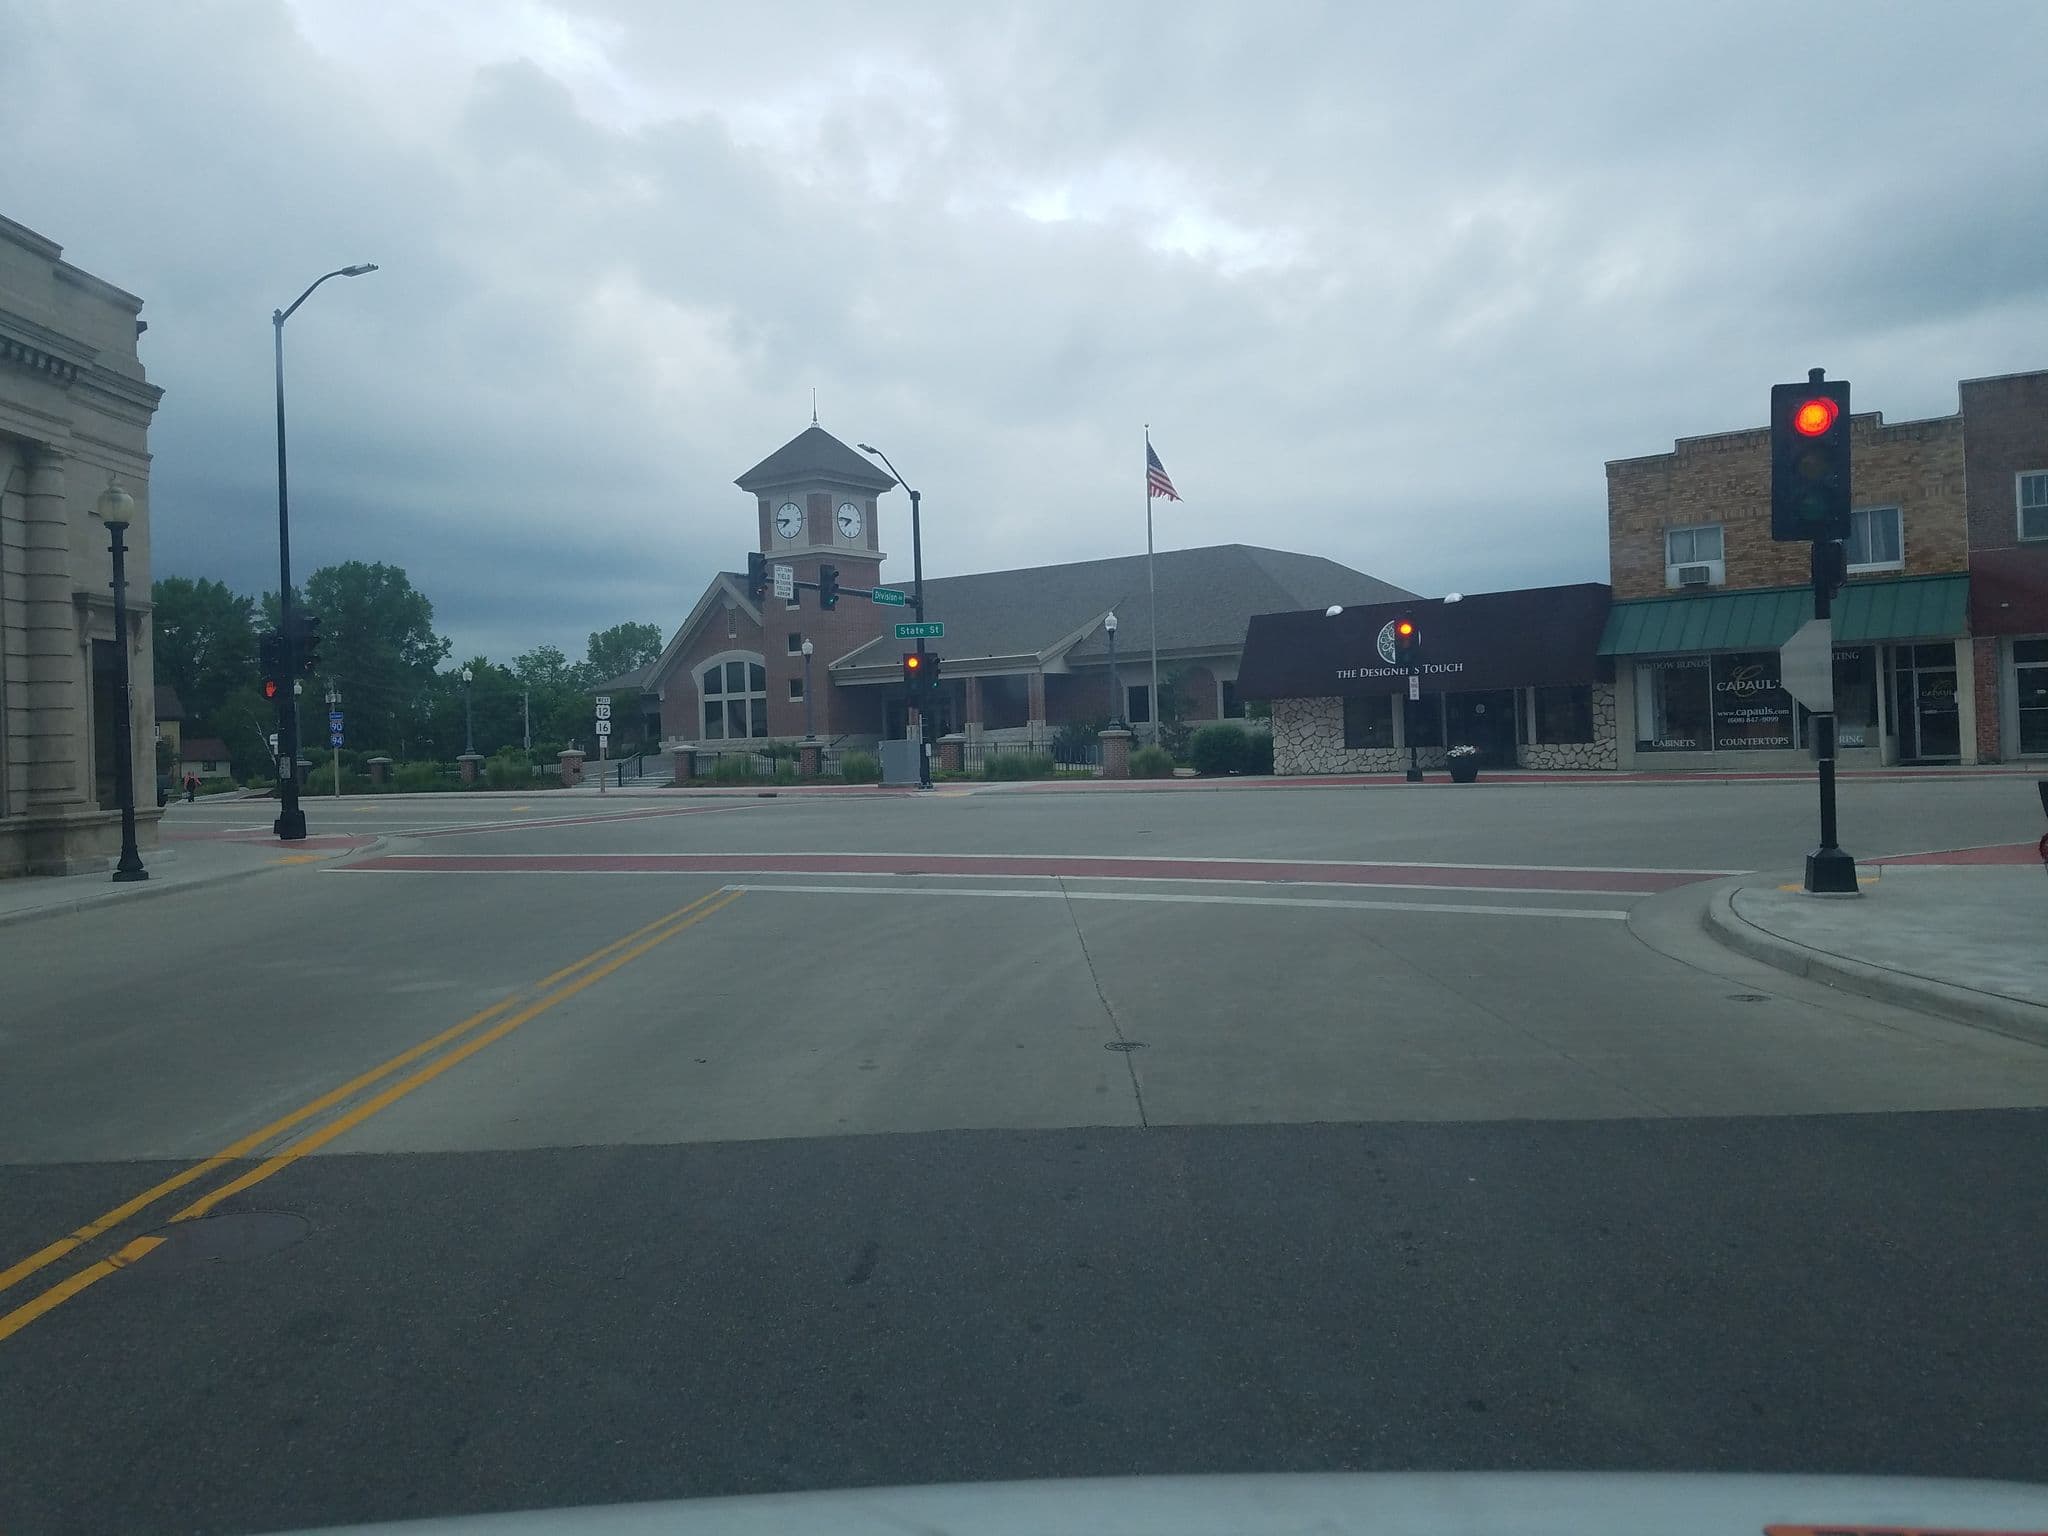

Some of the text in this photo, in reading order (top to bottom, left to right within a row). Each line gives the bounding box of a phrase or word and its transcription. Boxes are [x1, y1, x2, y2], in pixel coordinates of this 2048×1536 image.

[874, 590, 898, 602] Division
[900, 625, 939, 635] State St
[1336, 663, 1464, 679] THE DESIGNES TOUCH
[598, 707, 609, 717] 12
[1717, 706, 1790, 719] www.capauls.com
[331, 723, 343, 731] 90
[598, 723, 609, 732] 16
[1651, 739, 1696, 748] CABINETS
[1719, 736, 1789, 747] COUNTERTOPS
